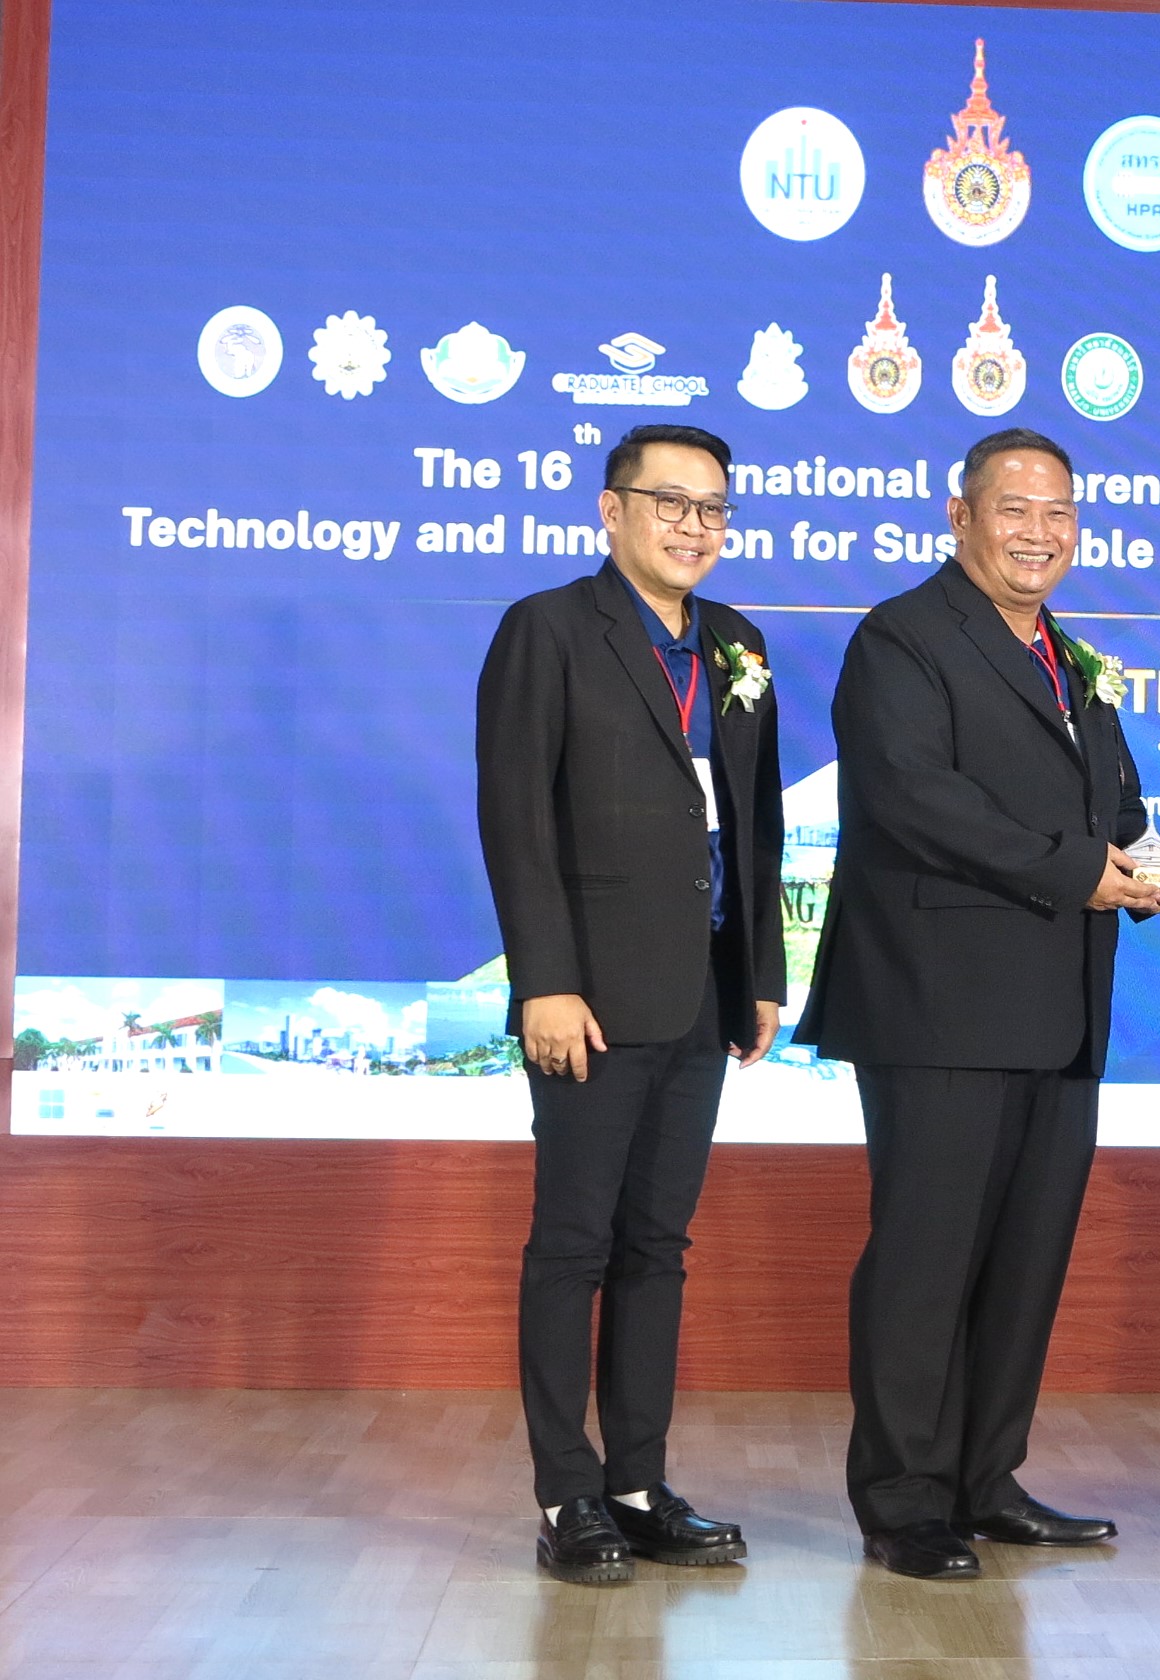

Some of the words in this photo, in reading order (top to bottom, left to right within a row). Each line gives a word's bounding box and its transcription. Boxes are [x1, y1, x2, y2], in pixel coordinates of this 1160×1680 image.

[771, 172, 835, 201] NTU
[413, 447, 502, 489] The
[122, 506, 402, 561] Technology
[416, 514, 505, 555] and
[791, 520, 858, 561] for
